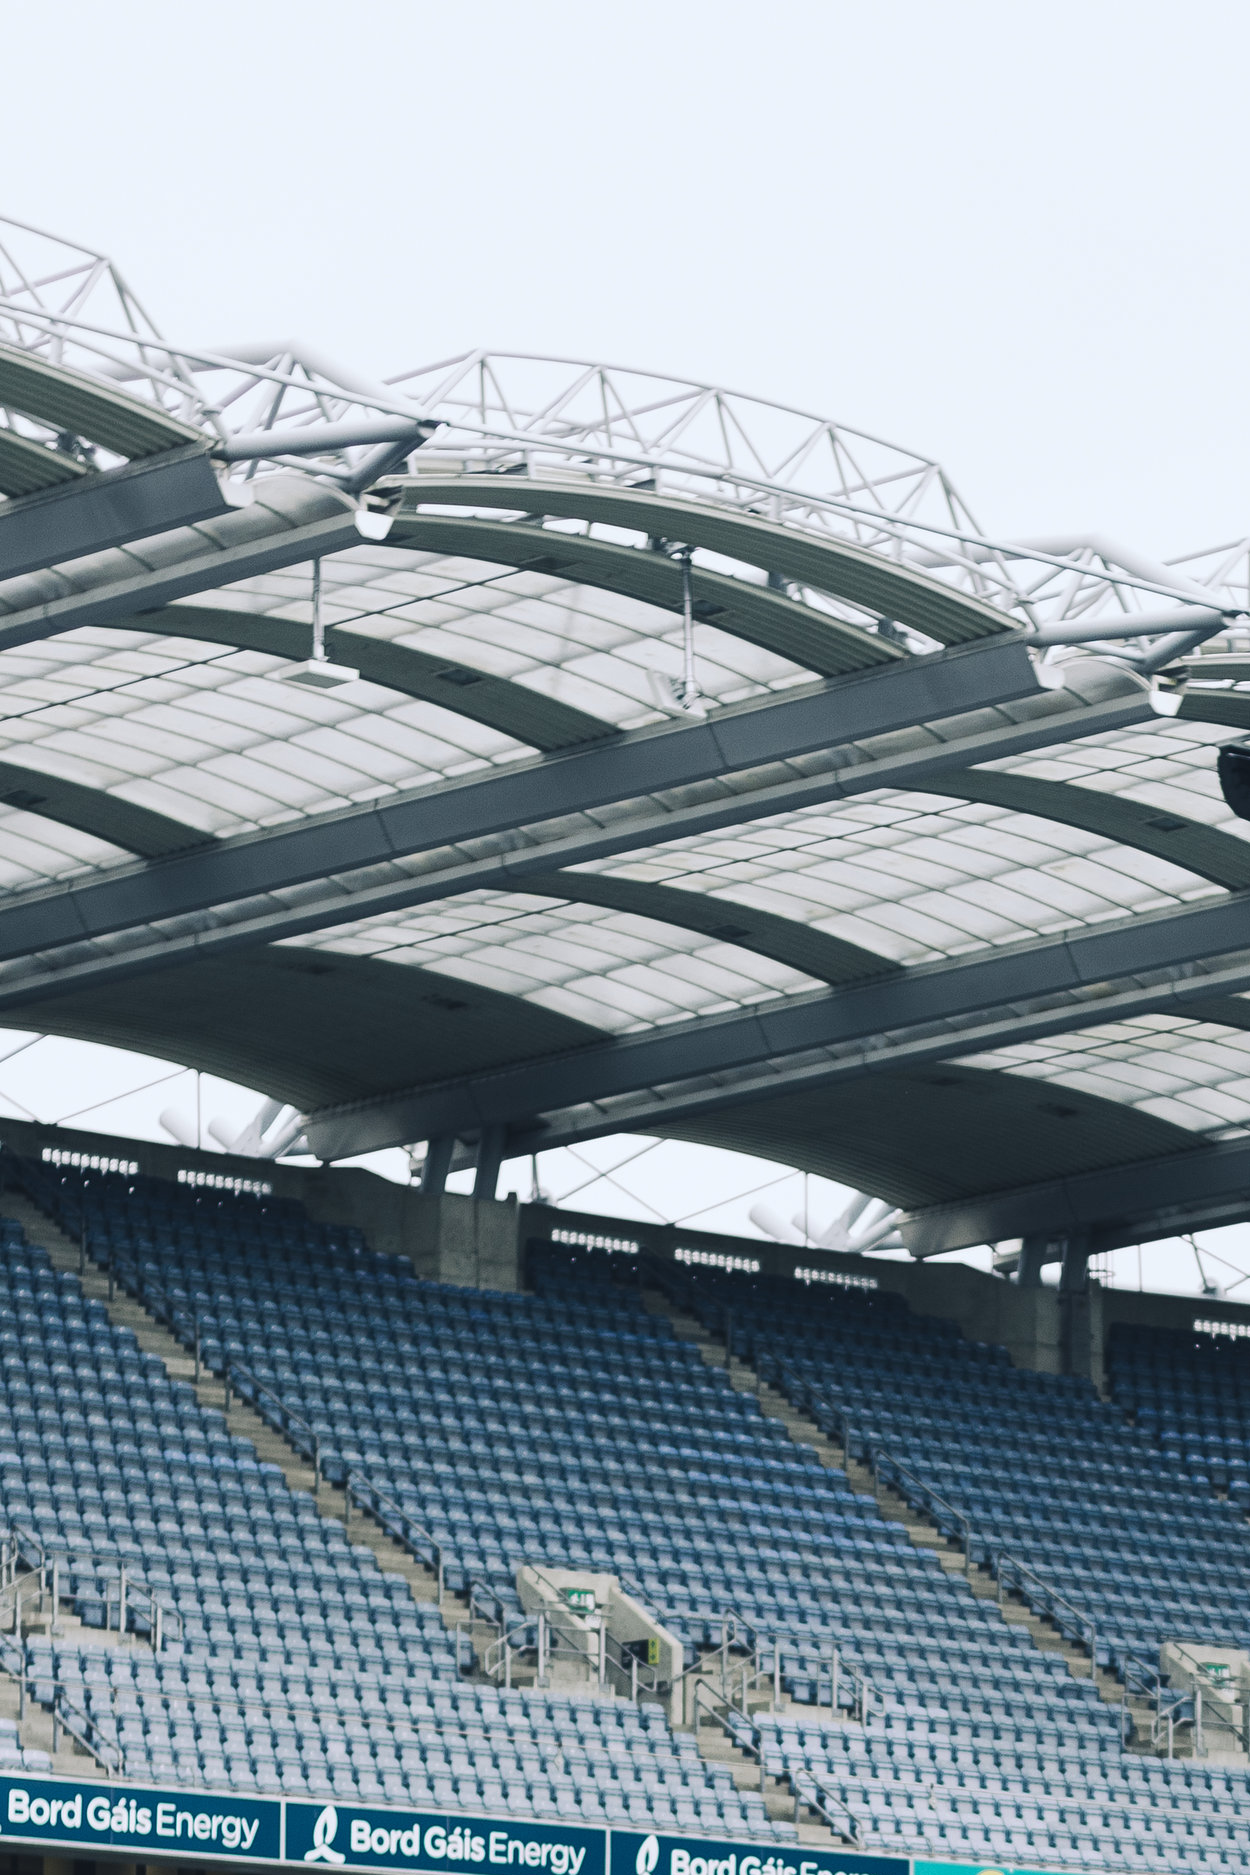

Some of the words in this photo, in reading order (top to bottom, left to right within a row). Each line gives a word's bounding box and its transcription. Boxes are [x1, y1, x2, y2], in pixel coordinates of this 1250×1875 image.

[8, 1789, 82, 1829] Bord
[87, 1797, 152, 1836] Gáis
[156, 1804, 260, 1850] Energy
[350, 1819, 419, 1857] Bord
[424, 1824, 486, 1863] Gáis
[489, 1832, 586, 1875] Energy
